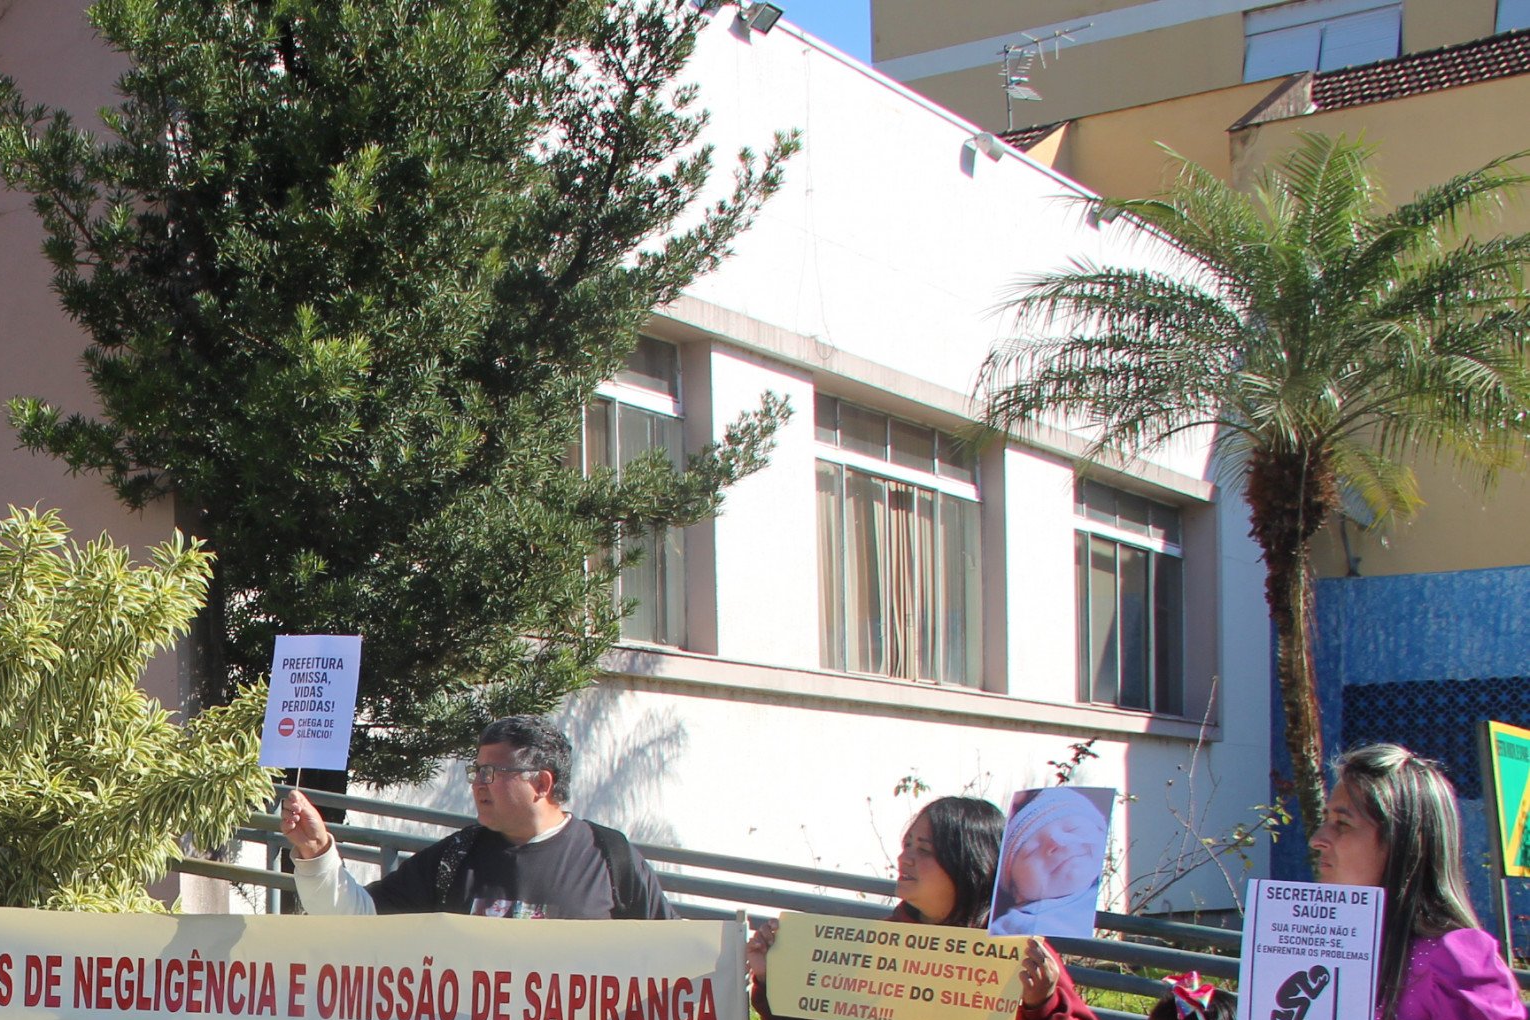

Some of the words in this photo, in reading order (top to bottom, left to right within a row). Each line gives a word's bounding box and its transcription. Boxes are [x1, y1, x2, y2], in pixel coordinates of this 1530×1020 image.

[282, 657, 344, 670] PREFEITURA
[290, 672, 331, 686] OMISSA,
[294, 686, 323, 698] VIDAS
[282, 700, 335, 713] PERDIDAS!
[298, 718, 321, 728] CHEGA
[324, 718, 334, 728] DE
[297, 728, 332, 739] SILÊNCIO!
[1266, 886, 1346, 904] SECRETÁRIA
[1351, 892, 1369, 905] DE
[1292, 903, 1336, 920] SAÚDE
[1271, 922, 1289, 933] SUA
[1291, 923, 1327, 936] FUNÇÃO
[1329, 924, 1348, 937] NÃO
[1351, 926, 1357, 937] É
[815, 925, 900, 946] VEREADOR
[905, 934, 940, 951] QUE
[944, 939, 967, 954] SE
[972, 942, 1019, 961] CALA
[1256, 944, 1262, 953] É
[1262, 945, 1306, 956] ENFRENTAR
[1308, 948, 1318, 958] OS
[1320, 950, 1369, 961] PROBLEMAS
[812, 949, 872, 968] DIANTE
[877, 957, 897, 972] DA
[902, 959, 999, 987] INJUSTIÇA
[24, 954, 62, 1008] DE
[73, 949, 277, 1017] NEGLIGÊNCIA
[287, 963, 307, 1018] E
[806, 969, 817, 986] É
[821, 973, 905, 998] CÚMPLICE
[910, 986, 934, 1002] DO
[940, 990, 1017, 1014] SILÊNCIO
[798, 996, 829, 1013] QUE
